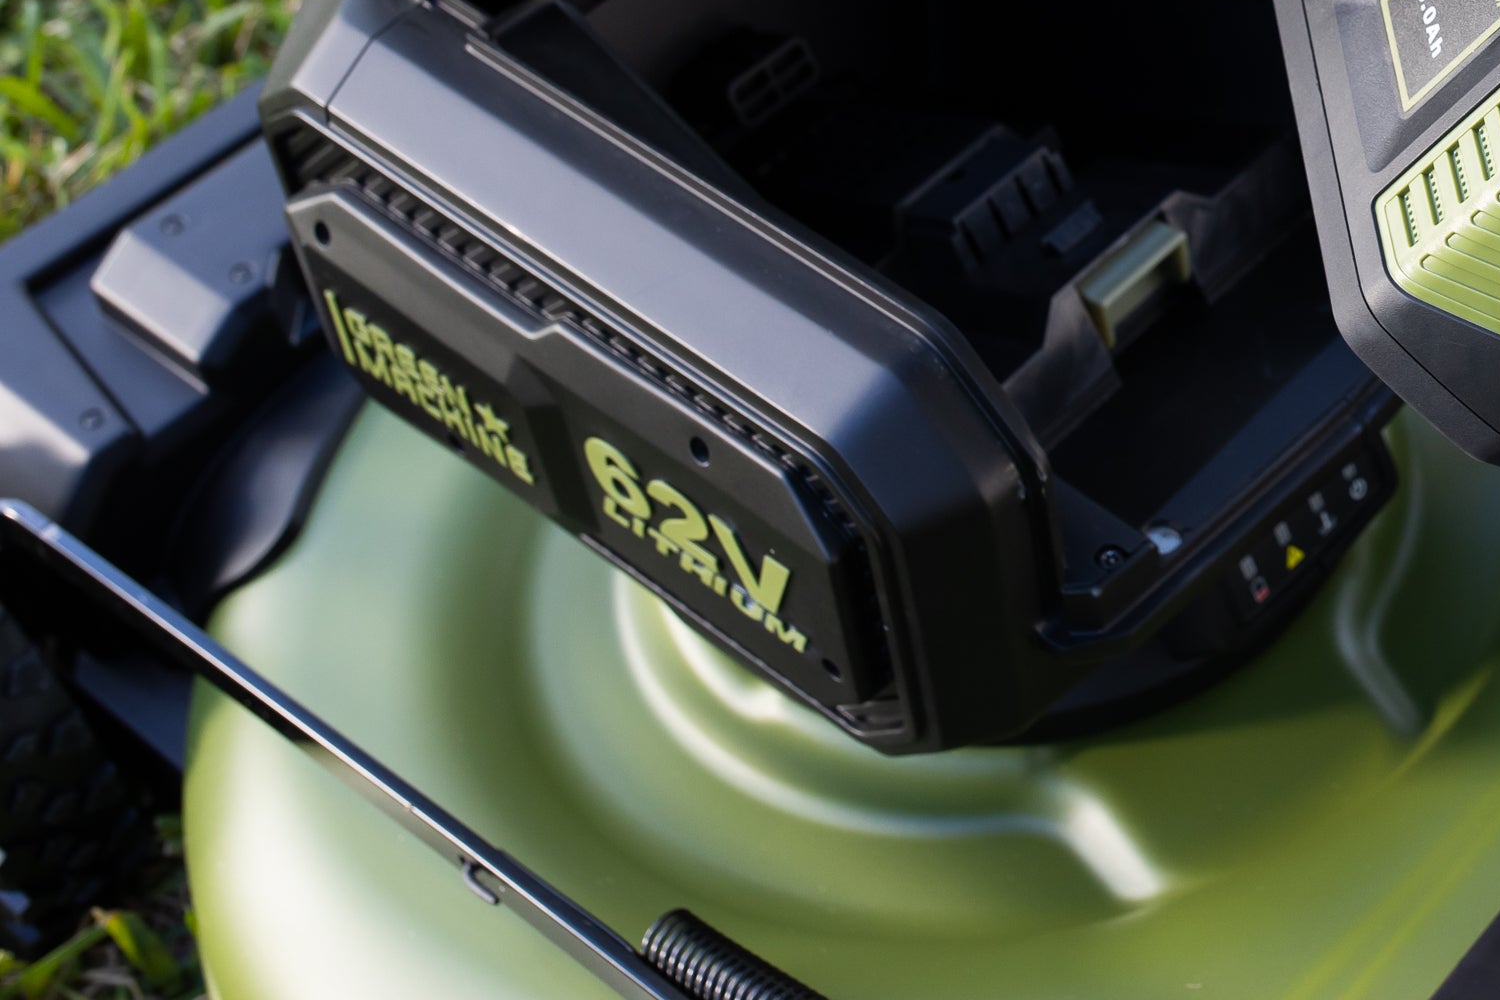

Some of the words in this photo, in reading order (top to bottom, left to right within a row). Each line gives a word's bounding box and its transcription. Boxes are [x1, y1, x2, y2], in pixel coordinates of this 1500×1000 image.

[344, 308, 472, 416] GREEN
[354, 339, 535, 486] MACHINE
[584, 436, 791, 616] 62V
